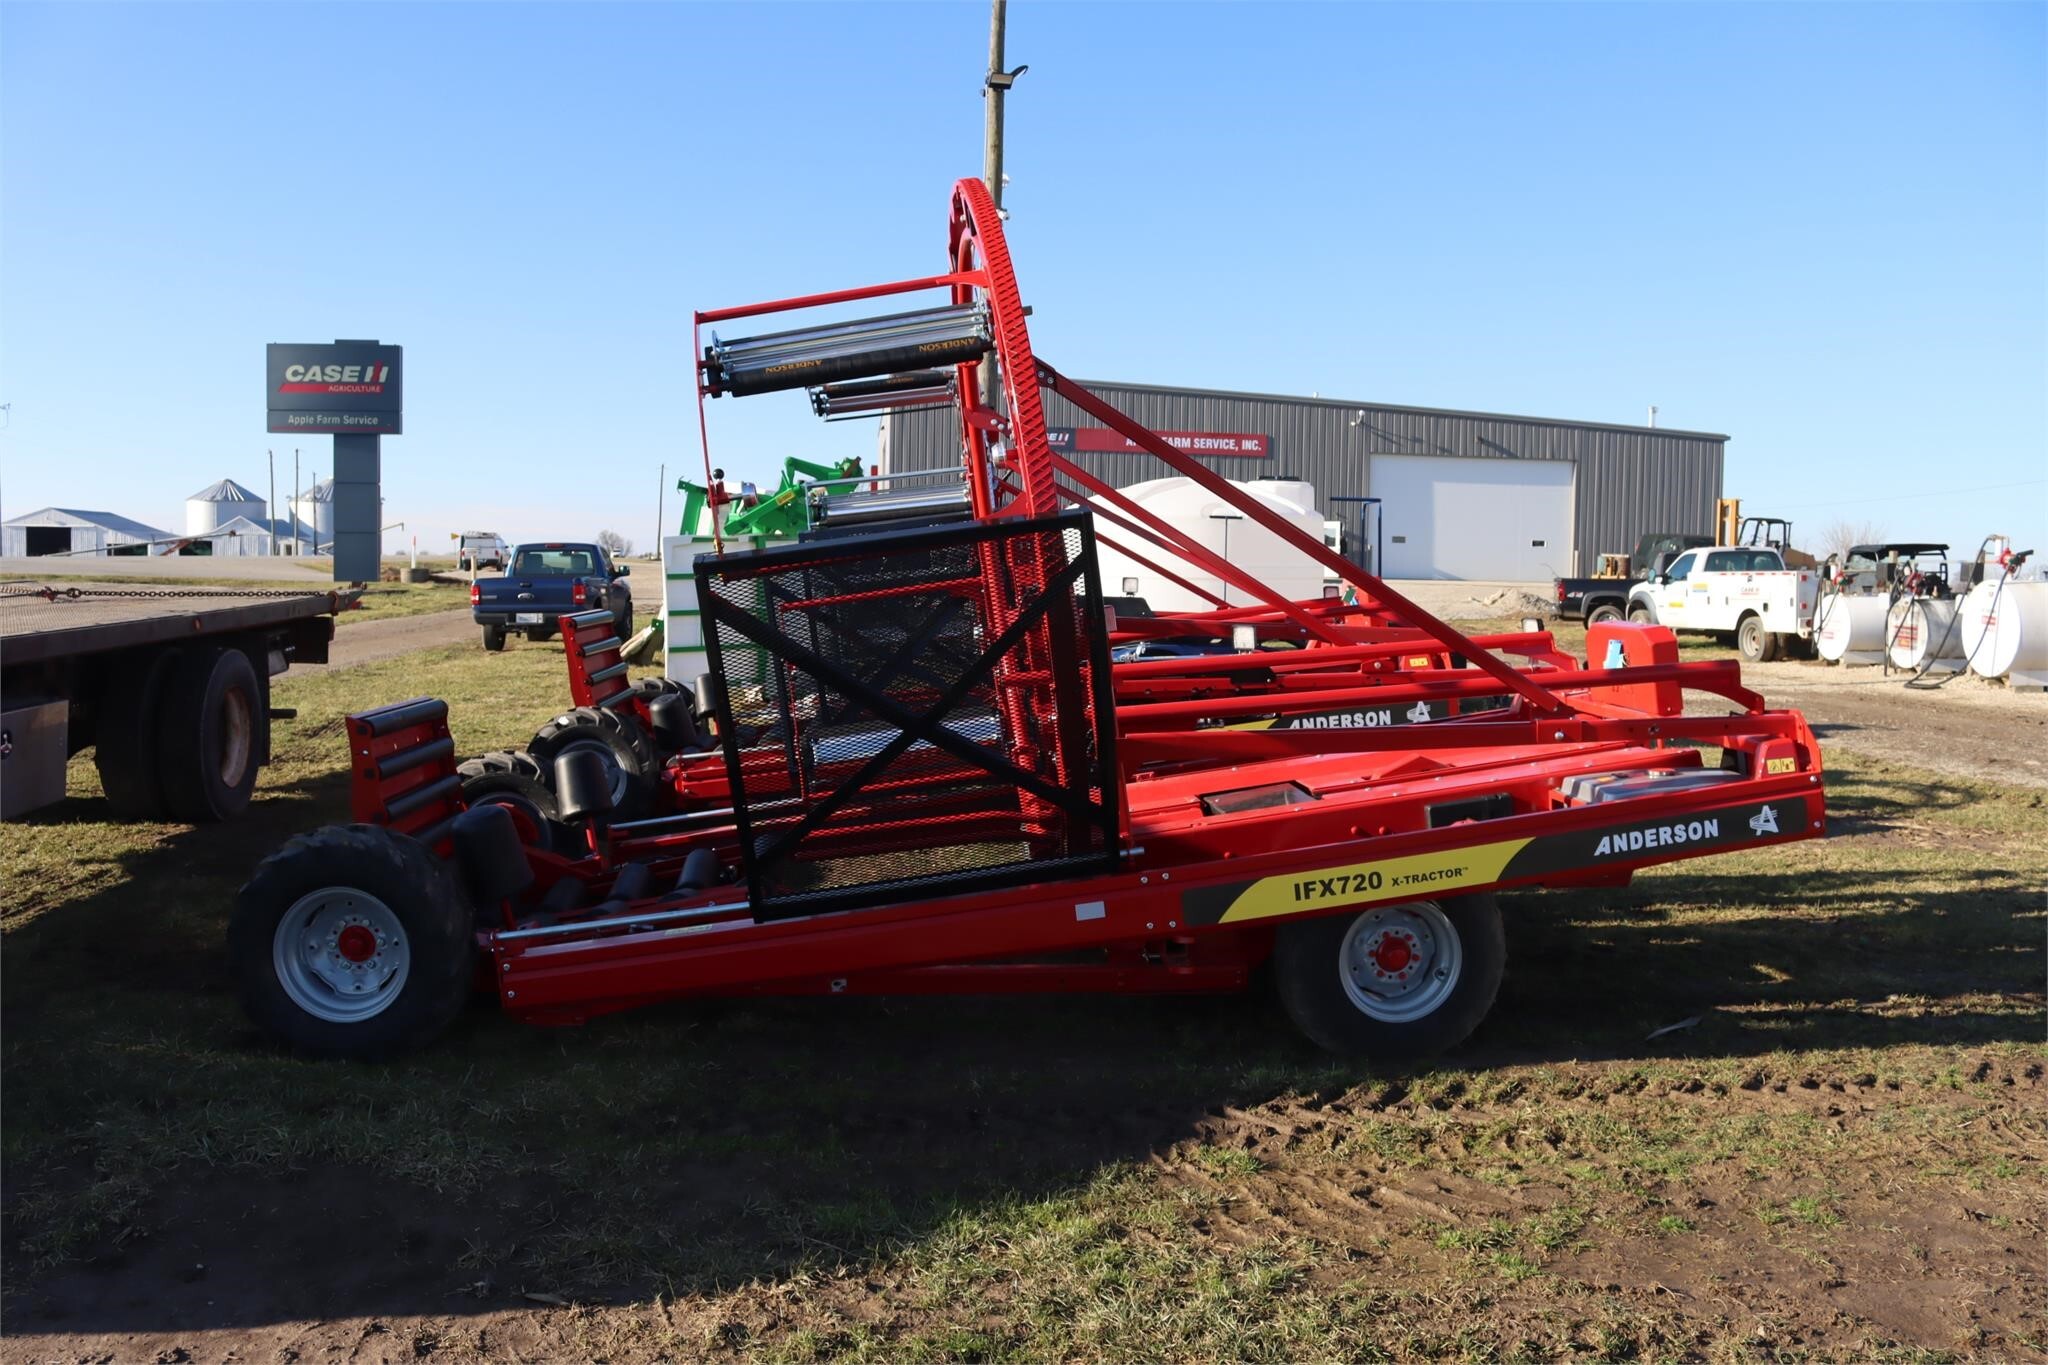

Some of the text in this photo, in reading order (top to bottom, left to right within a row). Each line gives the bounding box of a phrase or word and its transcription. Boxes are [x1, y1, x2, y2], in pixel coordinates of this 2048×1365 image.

[285, 364, 361, 383] CASE
[328, 385, 380, 393] AGRICULTURE
[288, 414, 378, 425] Apple Farm Service
[1193, 438, 1239, 451] SERVICE,
[1241, 440, 1262, 451] INC.
[1290, 710, 1391, 728] ANDERSON
[1594, 819, 1719, 856] ANDERSON
[1294, 871, 1383, 901] IFX720
